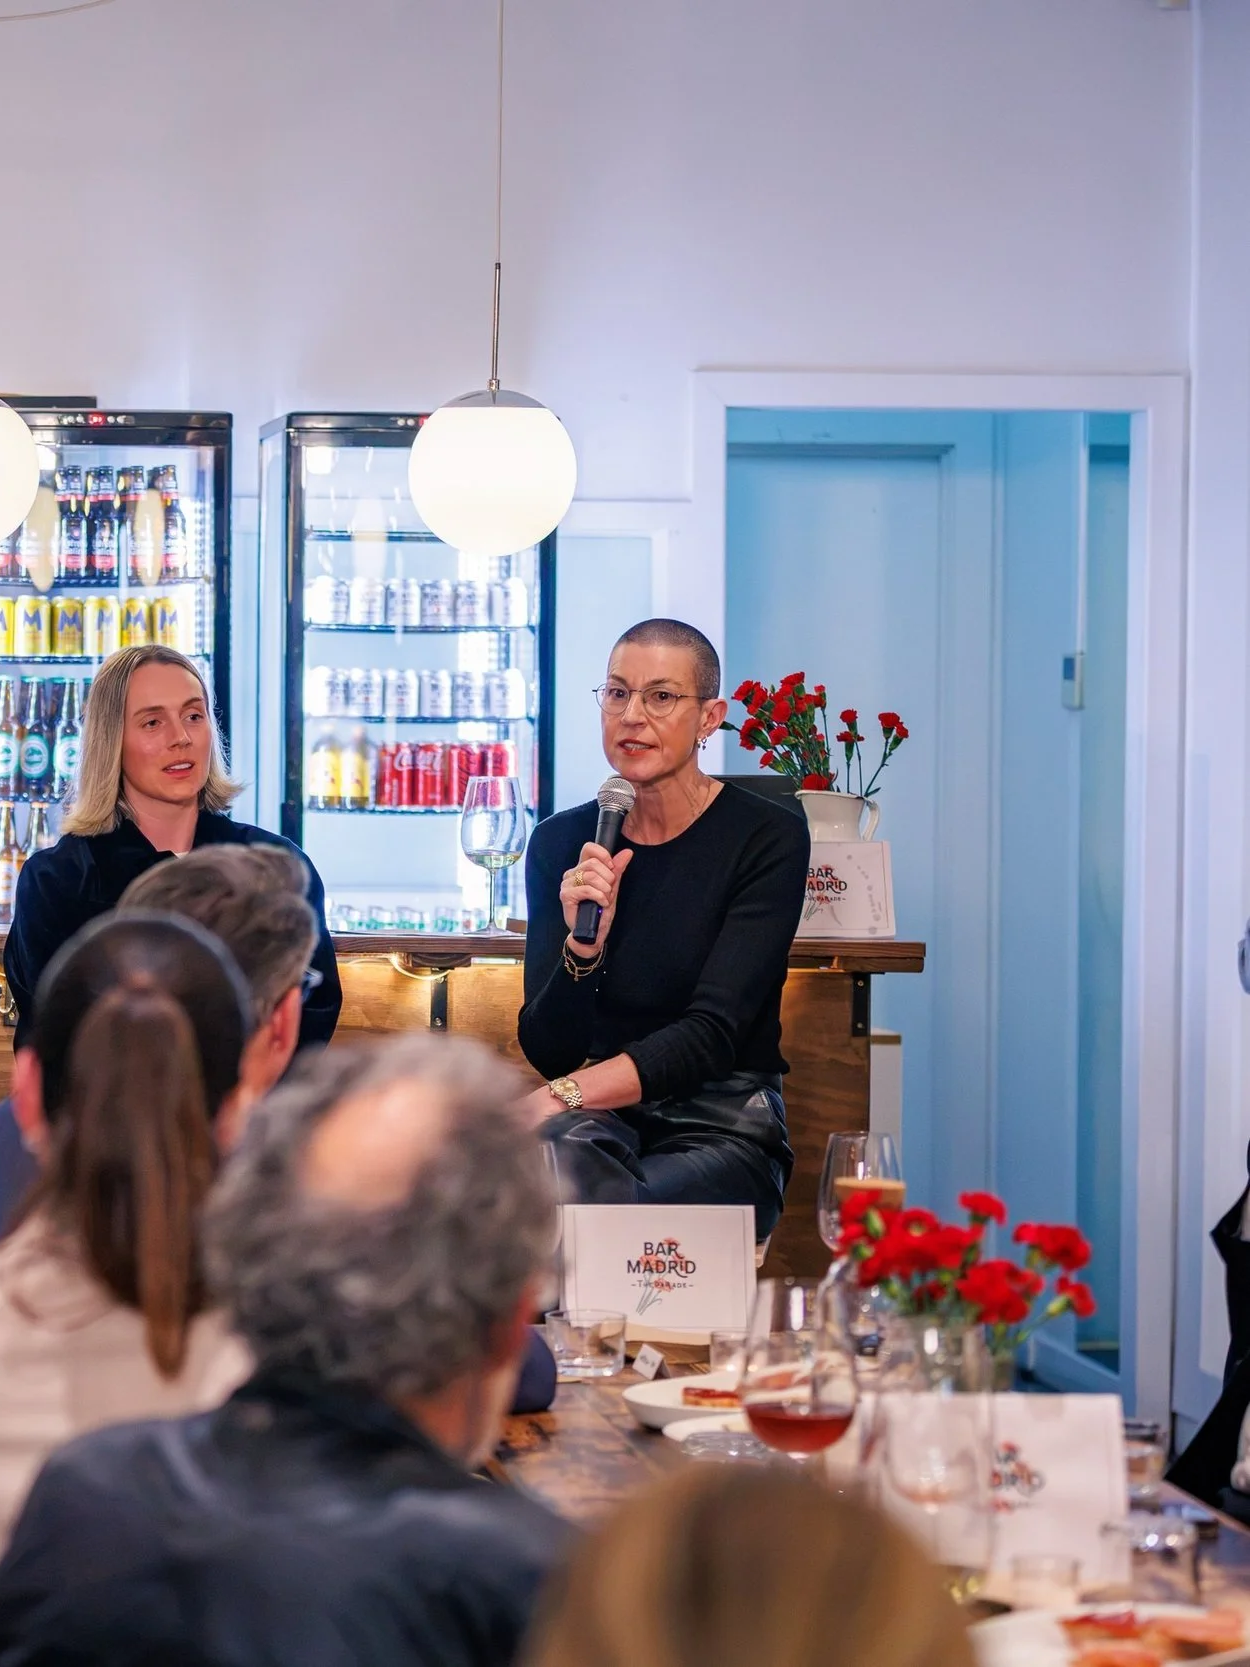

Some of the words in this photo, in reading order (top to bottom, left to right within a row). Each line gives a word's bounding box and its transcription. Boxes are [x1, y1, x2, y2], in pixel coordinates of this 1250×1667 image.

[807, 867, 839, 881] BAR
[806, 880, 848, 894] ADRID
[644, 1241, 685, 1260] BAR
[627, 1259, 697, 1279] MADRID
